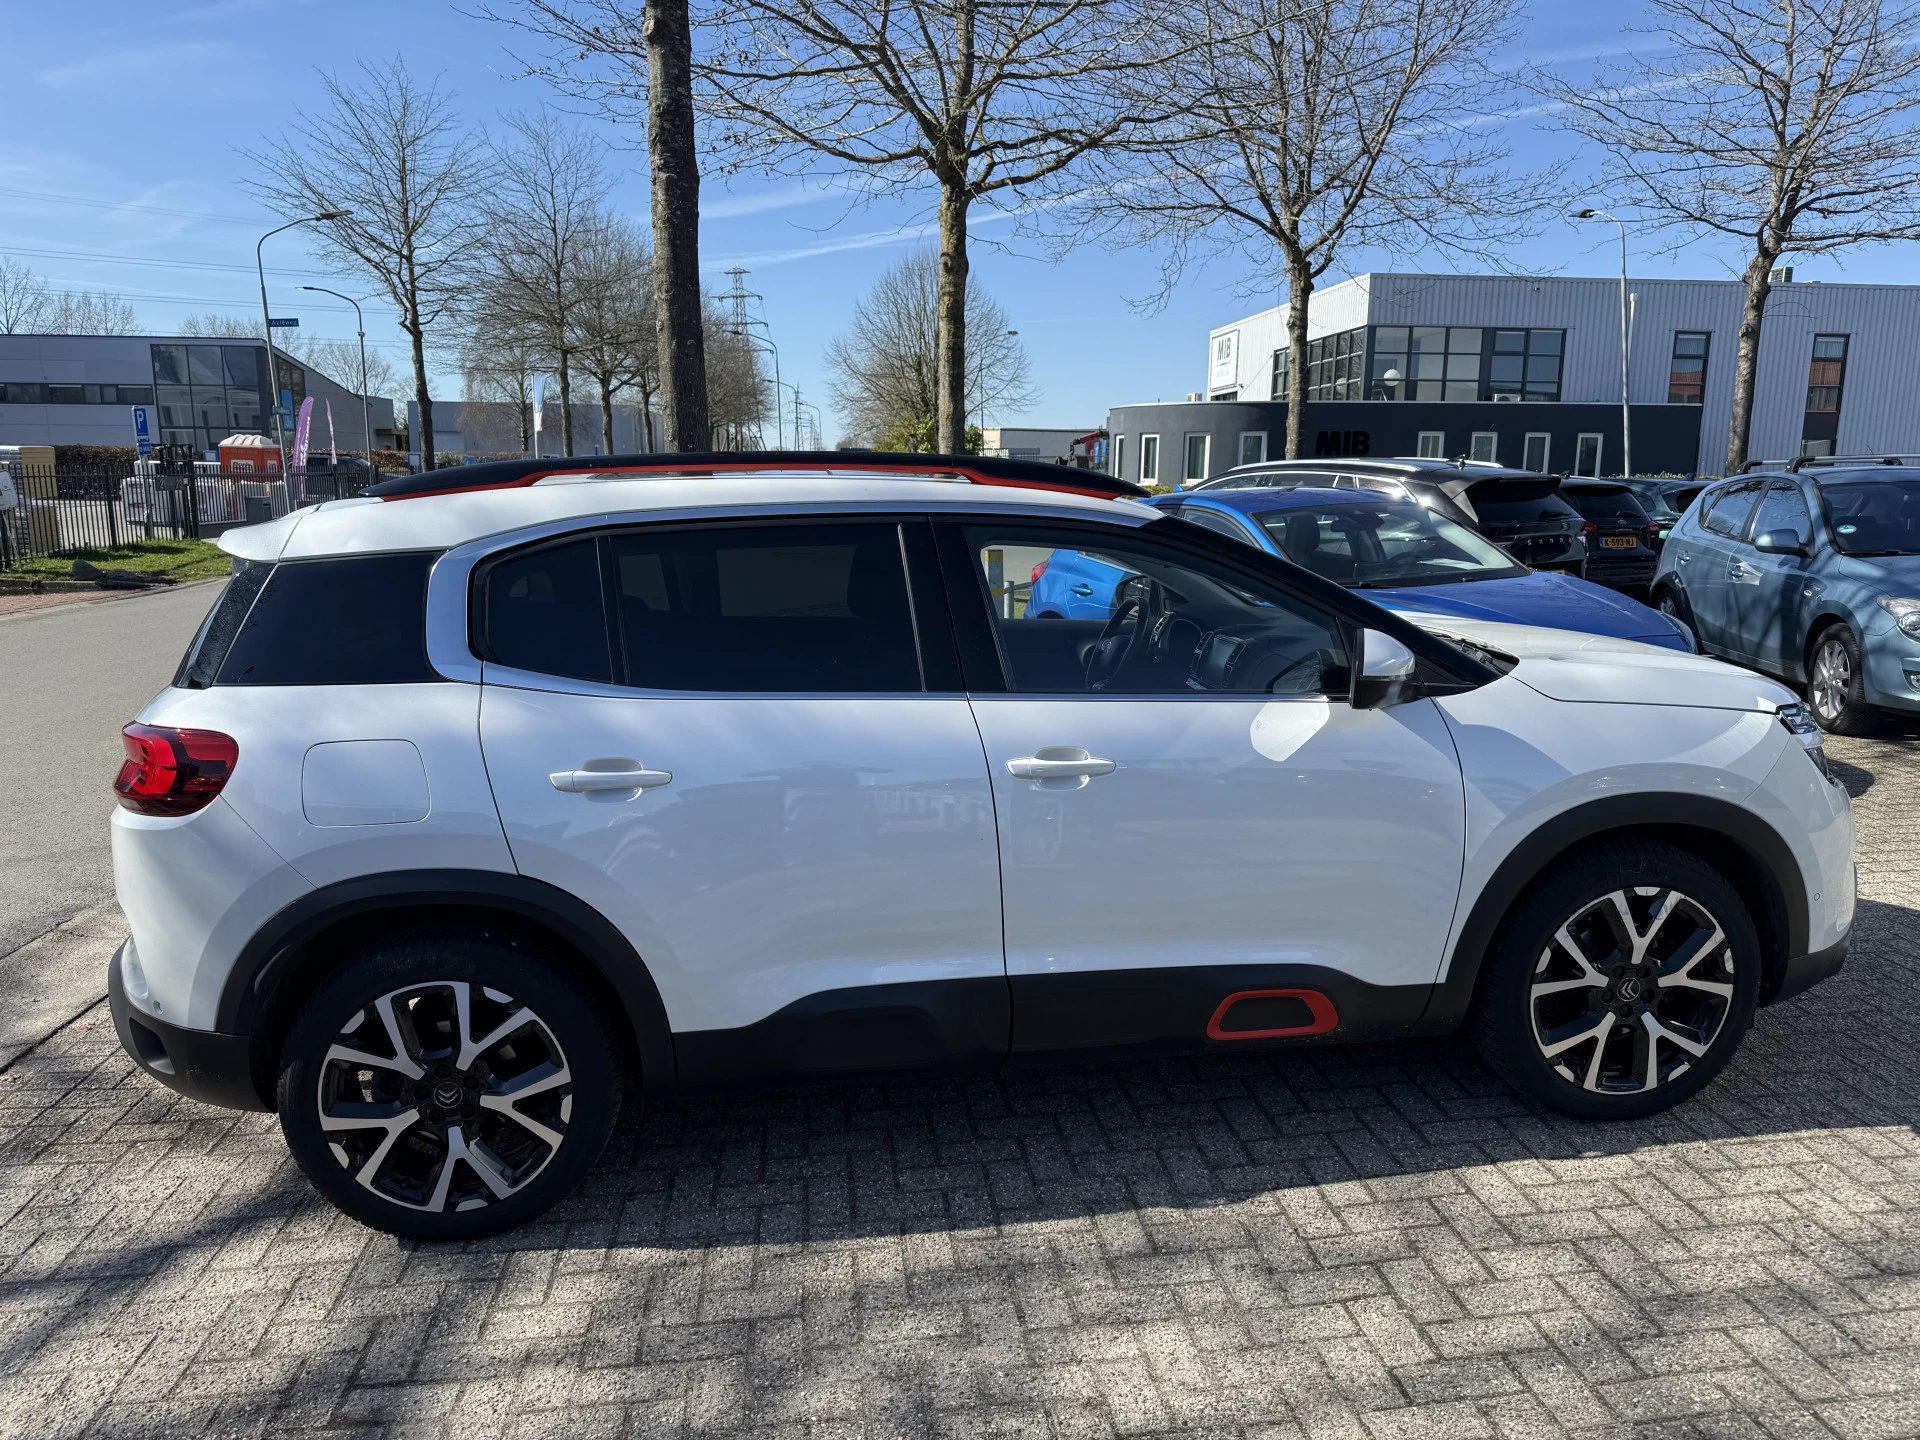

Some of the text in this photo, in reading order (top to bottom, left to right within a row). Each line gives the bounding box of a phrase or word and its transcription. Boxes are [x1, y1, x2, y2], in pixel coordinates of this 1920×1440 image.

[1217, 337, 1231, 361] MIB
[136, 410, 145, 430] P
[1315, 430, 1370, 456] MIB
[1604, 538, 1634, 547] K-593-NJ
